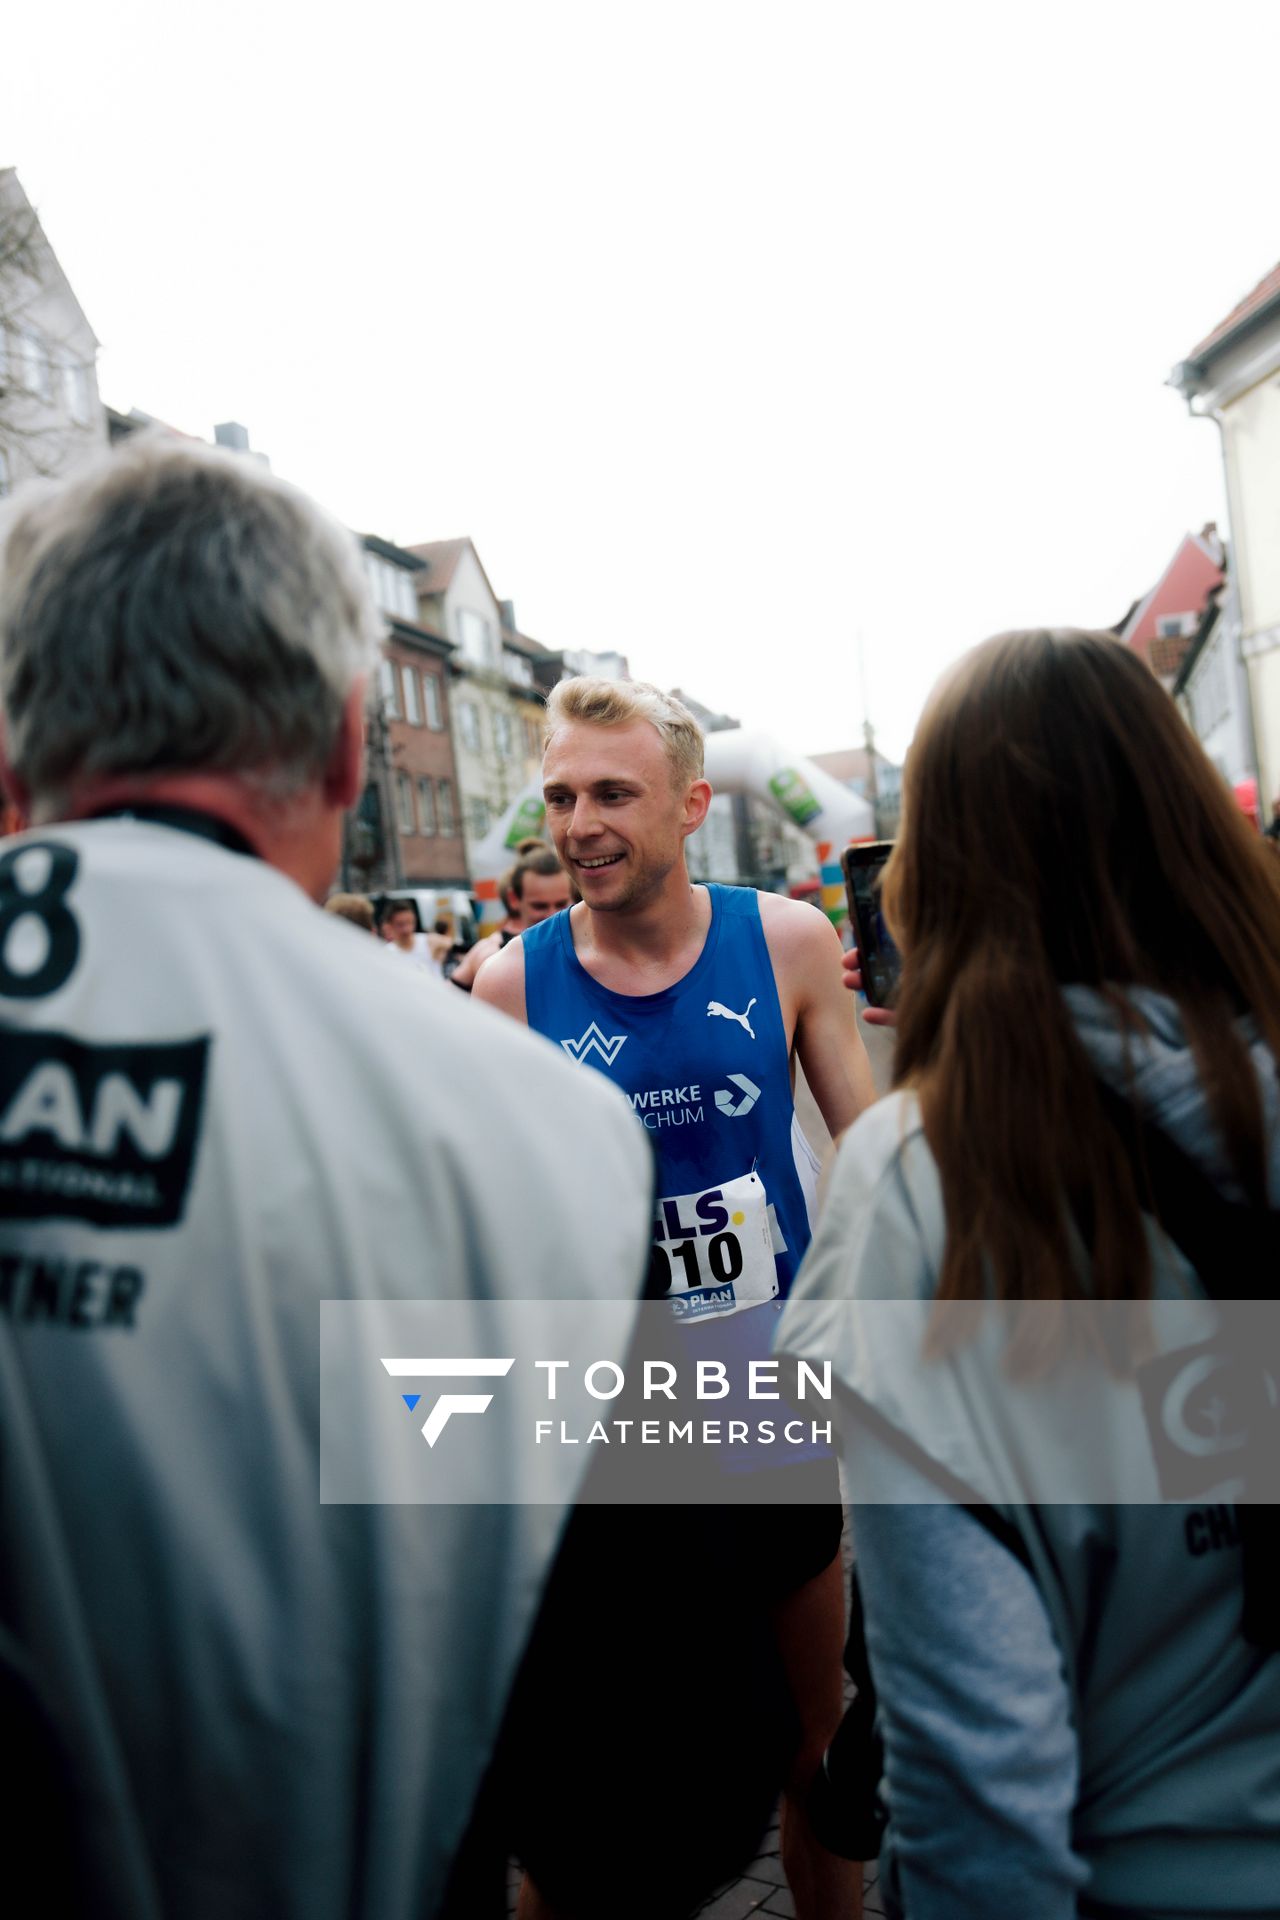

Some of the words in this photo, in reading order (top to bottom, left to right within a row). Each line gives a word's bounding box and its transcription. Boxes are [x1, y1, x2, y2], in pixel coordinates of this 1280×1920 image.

[0, 840, 81, 1002] 8
[625, 1084, 702, 1110] WERKE
[690, 1289, 732, 1307] PLAN
